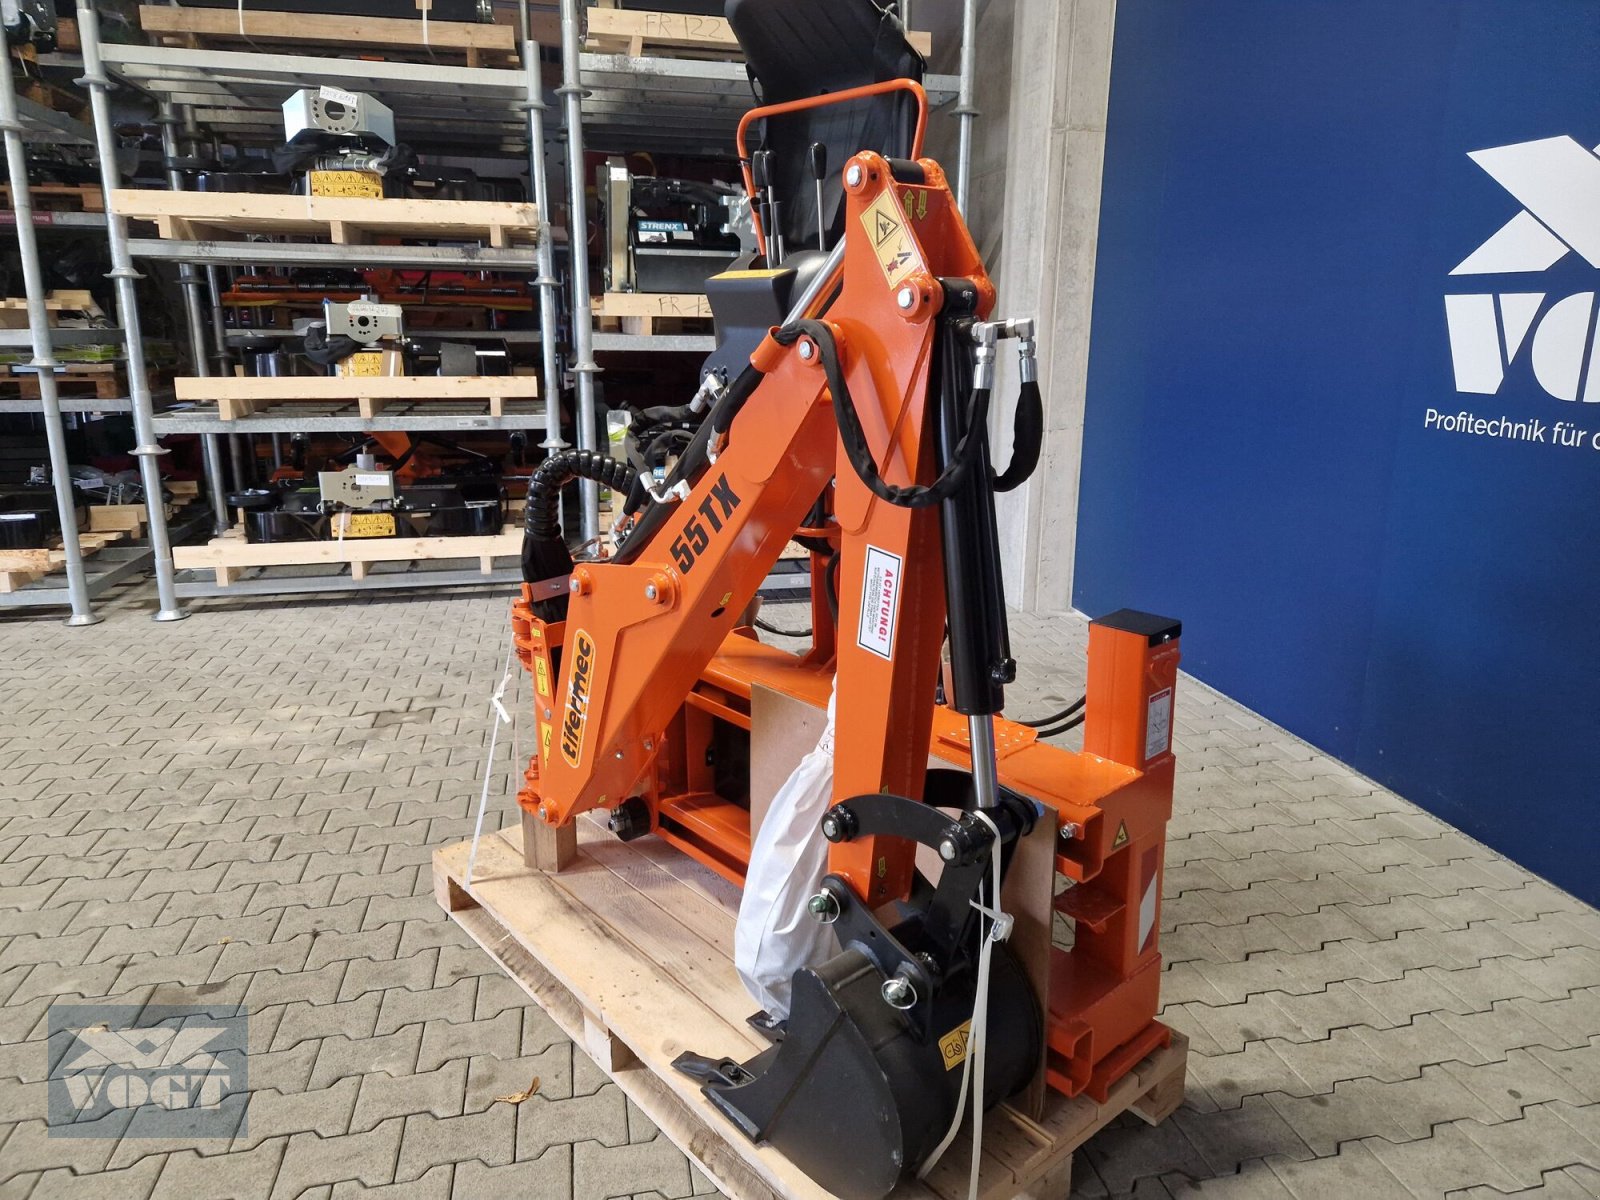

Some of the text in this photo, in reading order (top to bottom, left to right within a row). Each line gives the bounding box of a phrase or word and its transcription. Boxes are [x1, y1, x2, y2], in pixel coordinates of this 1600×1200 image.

[646, 13, 724, 40] FR 122
[640, 221, 679, 230] STRENX
[658, 296, 683, 315] FR
[1424, 408, 1547, 443] Profitechnik
[1552, 421, 1588, 448] für
[669, 472, 741, 575] 55TX
[878, 568, 894, 642] ACHTUNG!
[562, 636, 591, 759] tifermec
